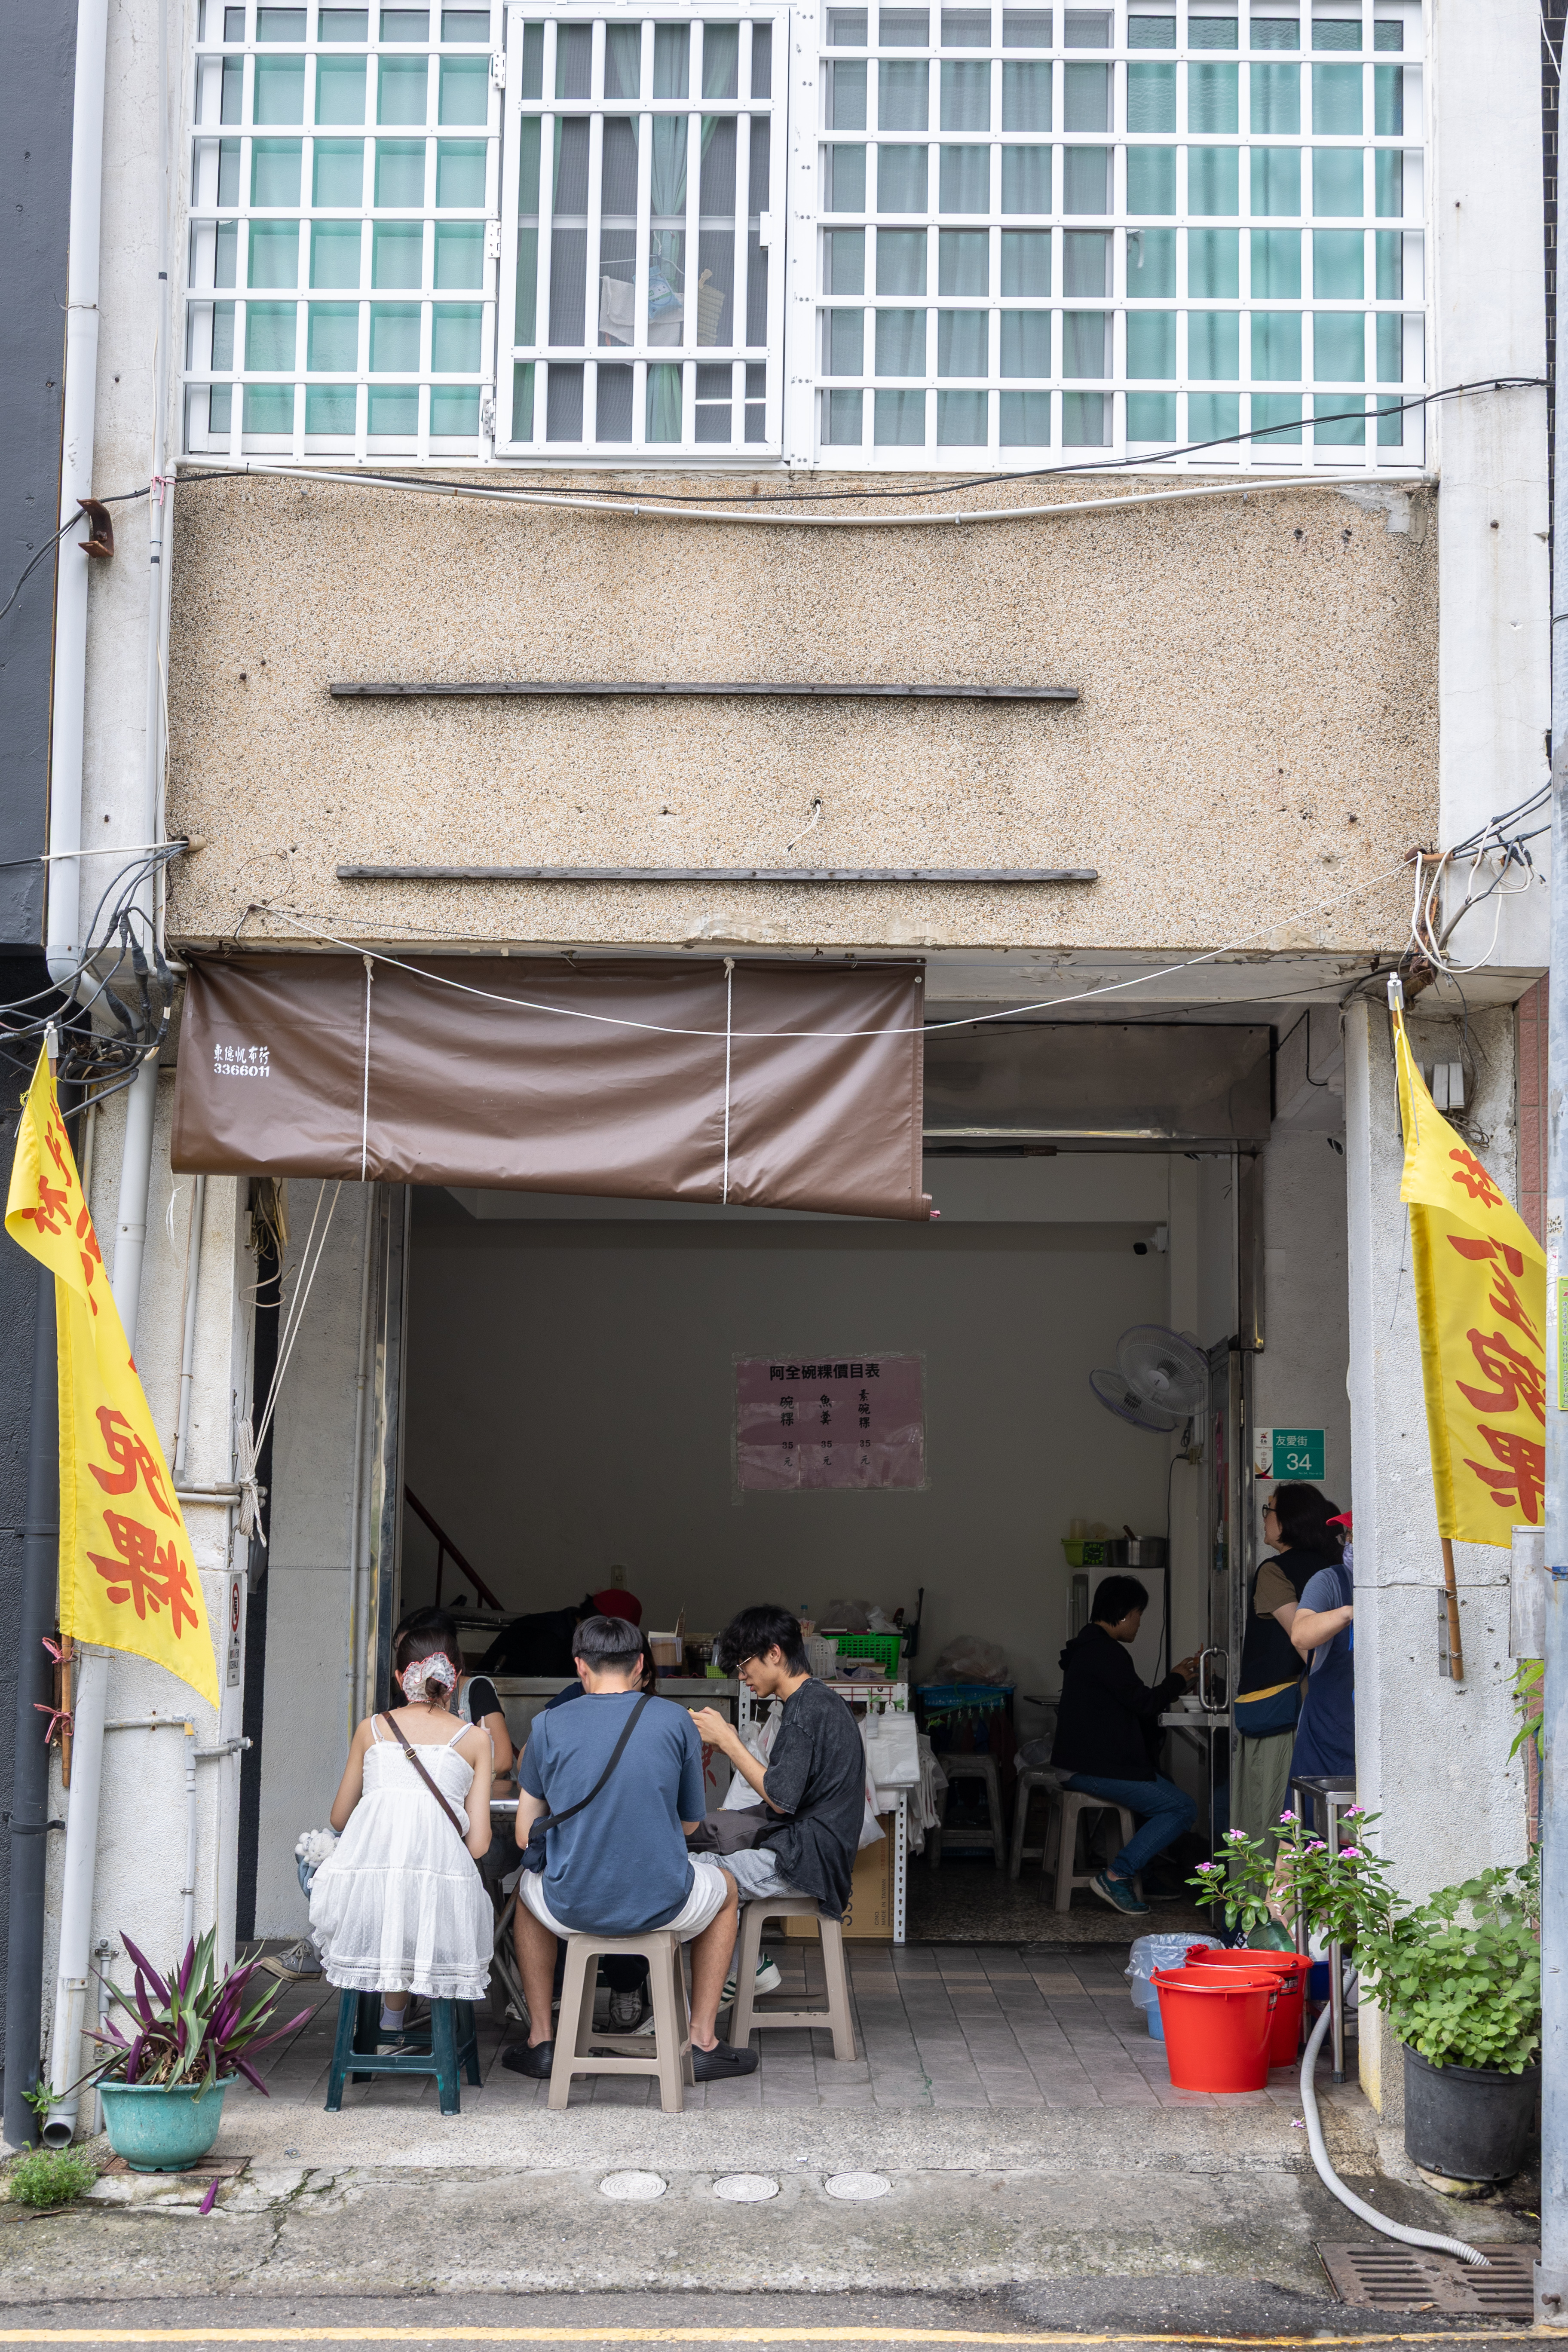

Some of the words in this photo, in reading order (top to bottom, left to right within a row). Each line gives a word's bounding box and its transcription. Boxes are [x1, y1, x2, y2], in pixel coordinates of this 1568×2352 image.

[214, 1044, 270, 1065] 東億帆布行
[214, 1063, 270, 1077] 3366011
[770, 1363, 880, 1381] 阿全碗粿價目表
[780, 1396, 795, 1427] 碗粿
[819, 1394, 833, 1425] 魚羹
[858, 1388, 871, 1429] 素碗粿
[782, 1441, 794, 1449] 35
[821, 1440, 833, 1449] 35
[860, 1439, 871, 1448] 35
[1276, 1435, 1308, 1446] 友愛街
[783, 1457, 793, 1467] 元
[822, 1456, 832, 1466] 元
[860, 1455, 870, 1465] 元
[1286, 1453, 1312, 1470] 34
